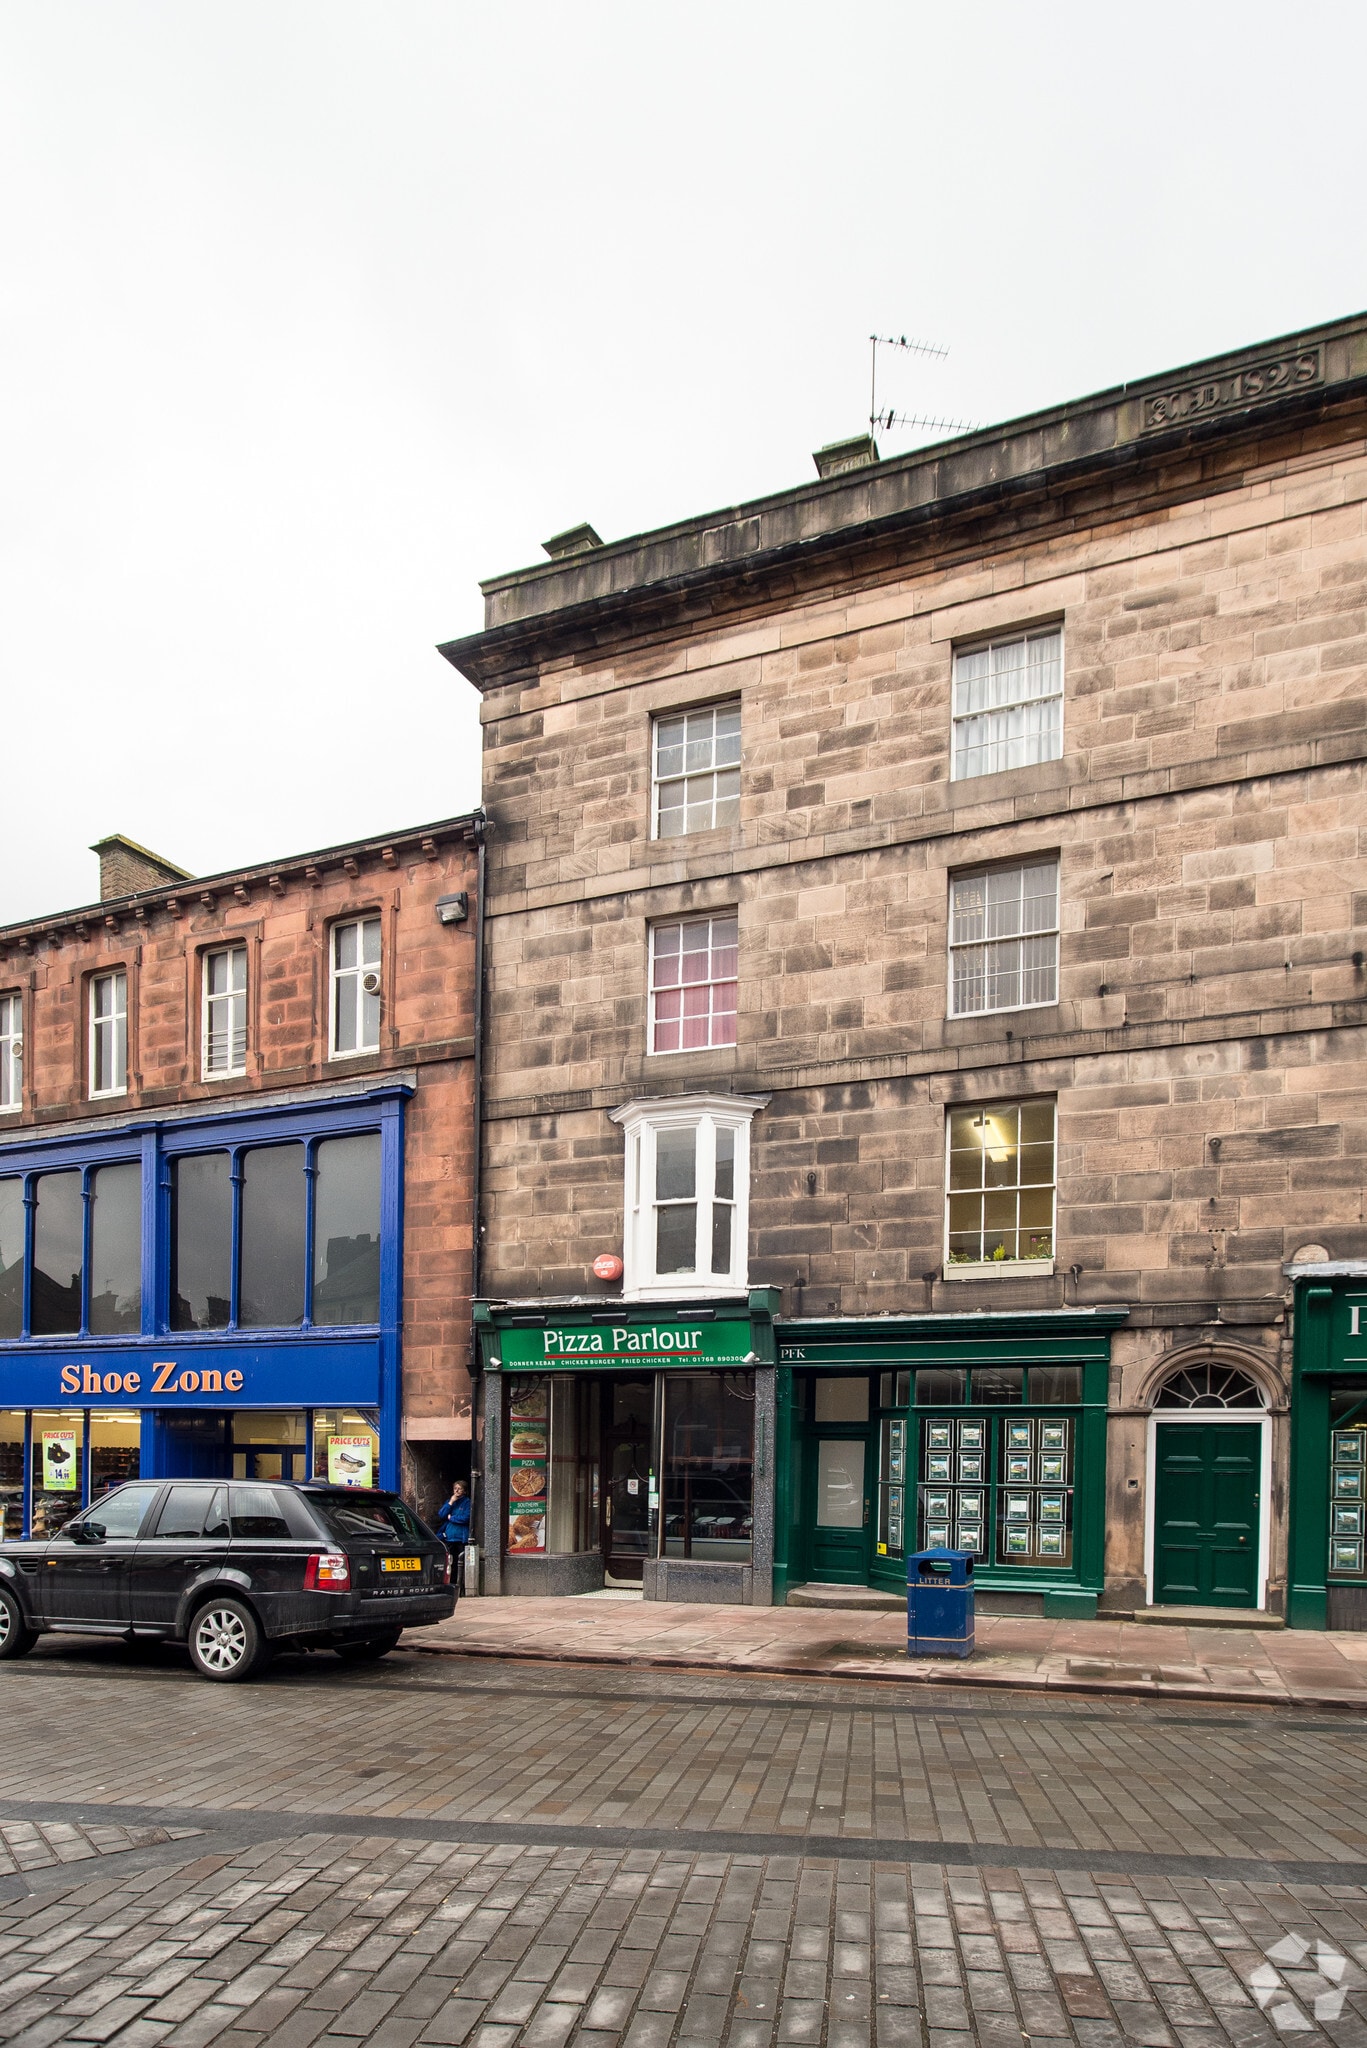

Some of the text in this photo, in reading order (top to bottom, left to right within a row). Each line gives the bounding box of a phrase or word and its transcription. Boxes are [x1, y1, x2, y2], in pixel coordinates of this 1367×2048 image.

[543, 1327, 702, 1352] Pizza Parlour
[781, 1348, 806, 1359] PFK
[61, 1362, 244, 1394] Shoe Zone
[330, 1437, 370, 1445] PRICE CUTS
[401, 1559, 416, 1569] TEE
[919, 1577, 951, 1585] LITTER
